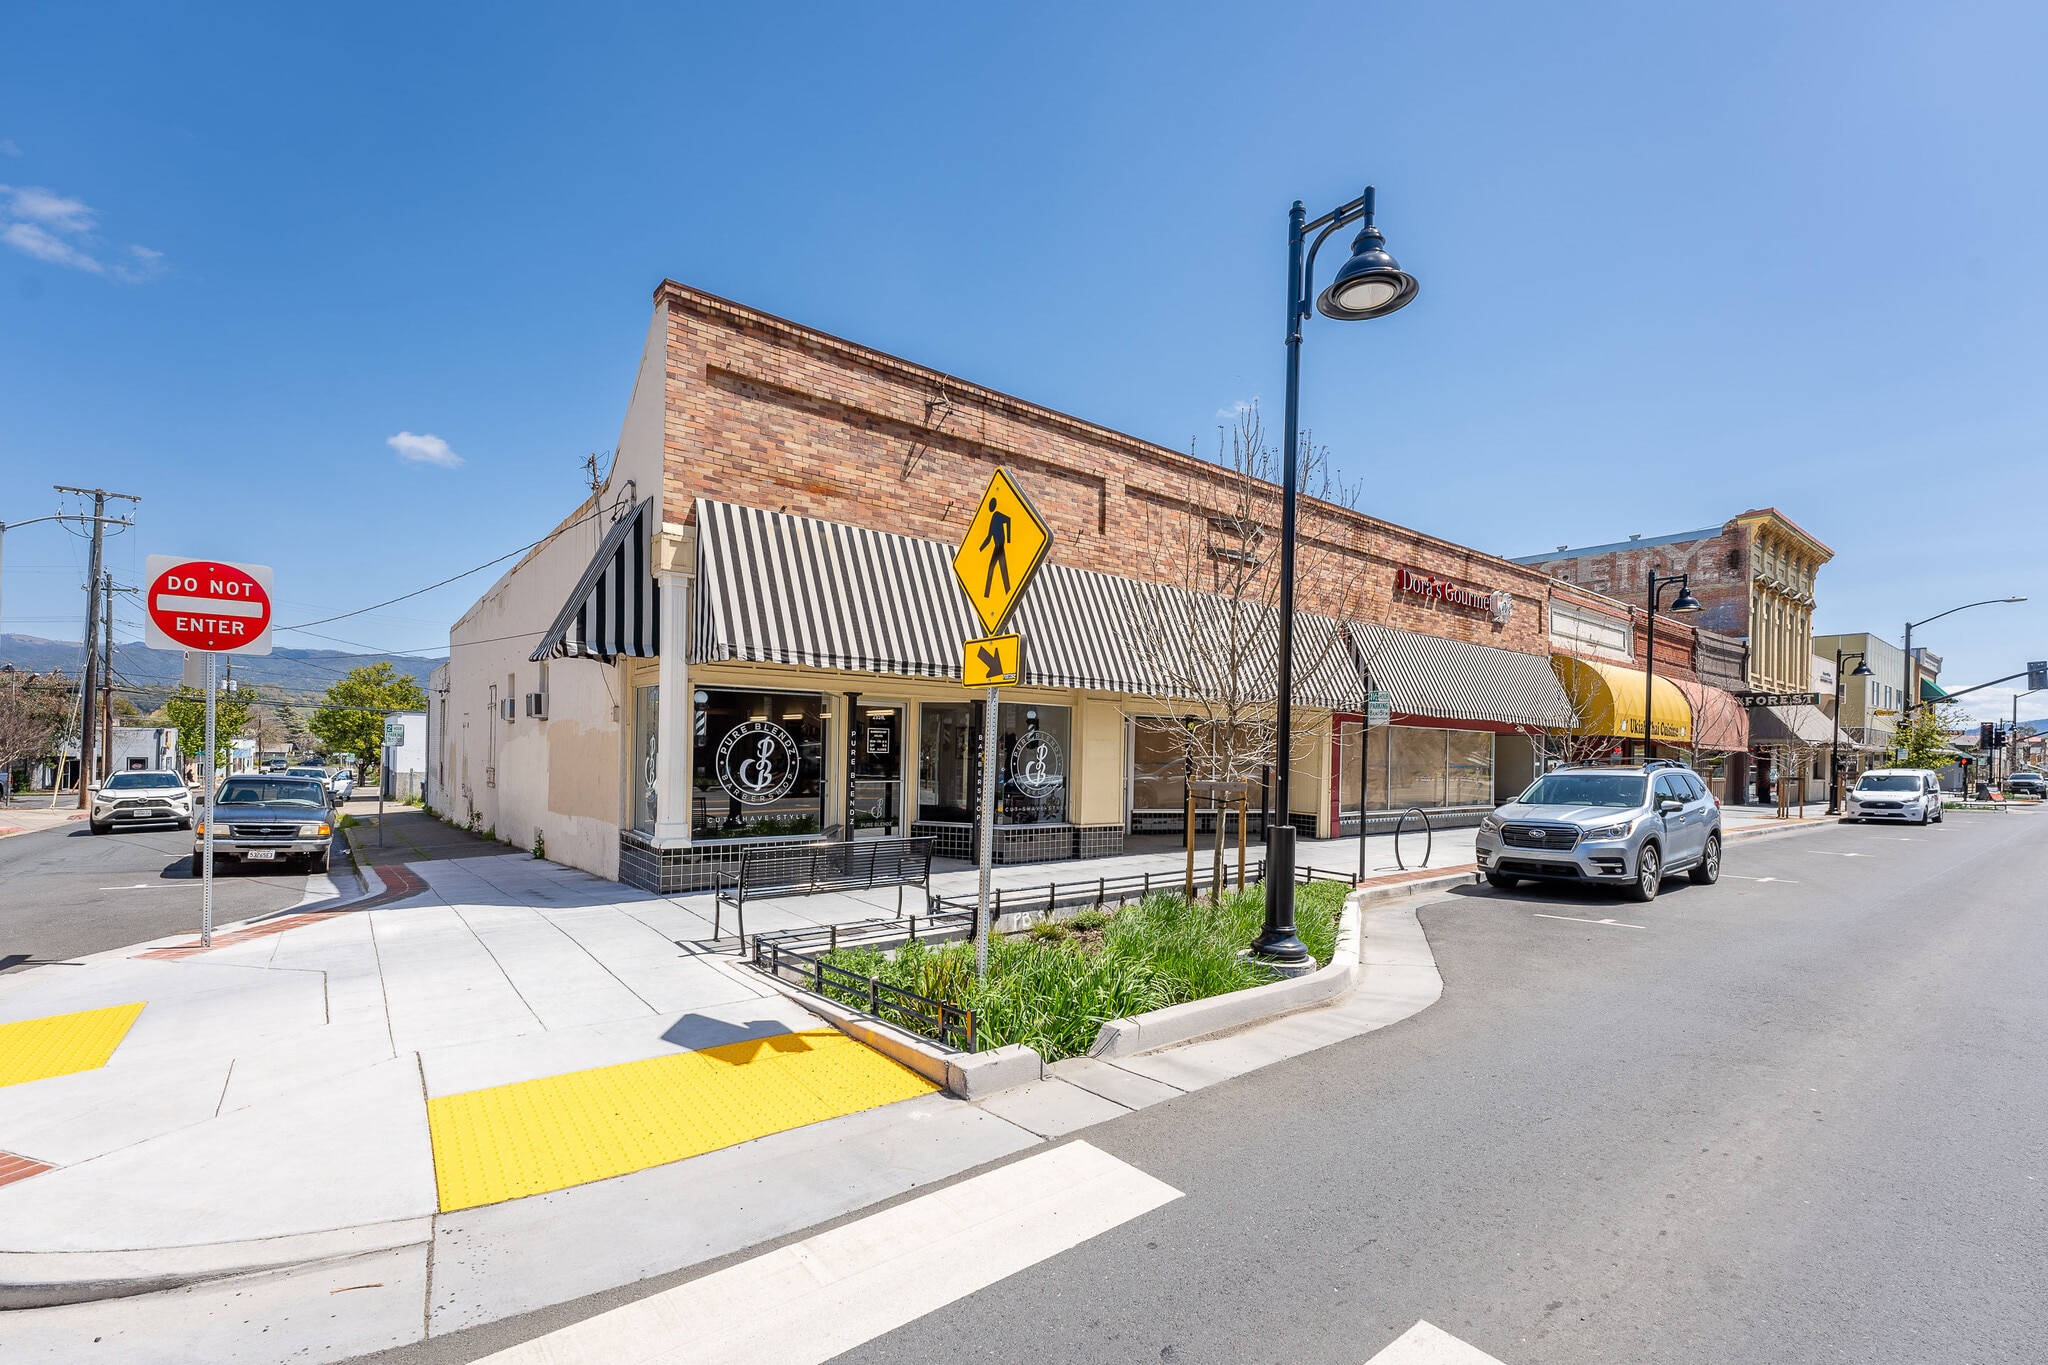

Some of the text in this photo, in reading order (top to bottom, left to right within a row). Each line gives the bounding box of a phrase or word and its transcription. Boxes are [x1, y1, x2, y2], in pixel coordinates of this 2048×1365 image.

[167, 575, 254, 597] DO NOT
[1397, 568, 1494, 612] Dora's Gourmet
[176, 616, 245, 636] ENTER
[1370, 702, 1389, 710] PARKING
[1745, 694, 1815, 707] FOREST
[720, 722, 796, 755] PURE BLENDZ
[721, 773, 794, 802] BARBERSHOP
[707, 816, 728, 824] CUT
[776, 813, 807, 821] STYLE
